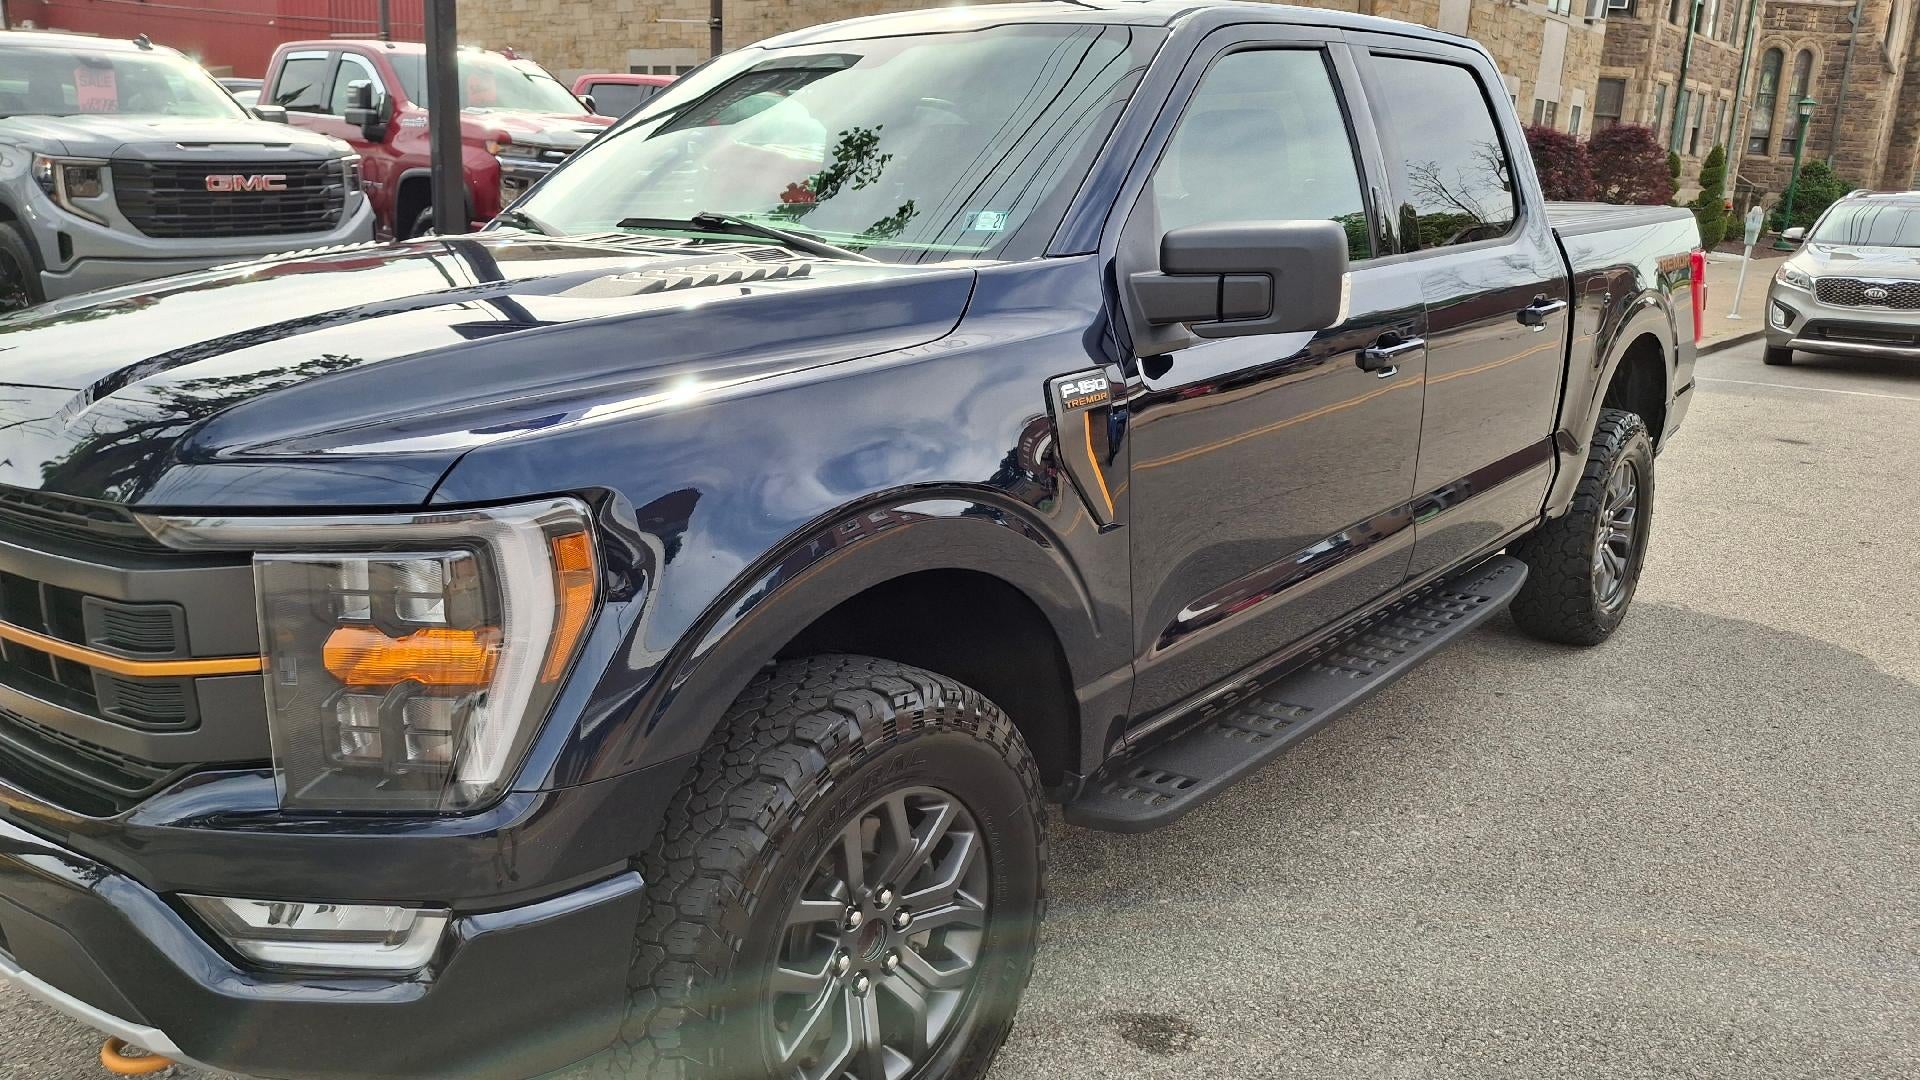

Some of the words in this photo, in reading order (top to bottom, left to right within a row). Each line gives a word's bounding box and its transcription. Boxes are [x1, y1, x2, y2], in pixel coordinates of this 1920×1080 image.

[79, 71, 113, 88] SALE
[205, 174, 288, 192] GMC
[992, 213, 1006, 229] 27
[1060, 378, 1107, 398] F-150
[1065, 392, 1108, 409] TREMOR
